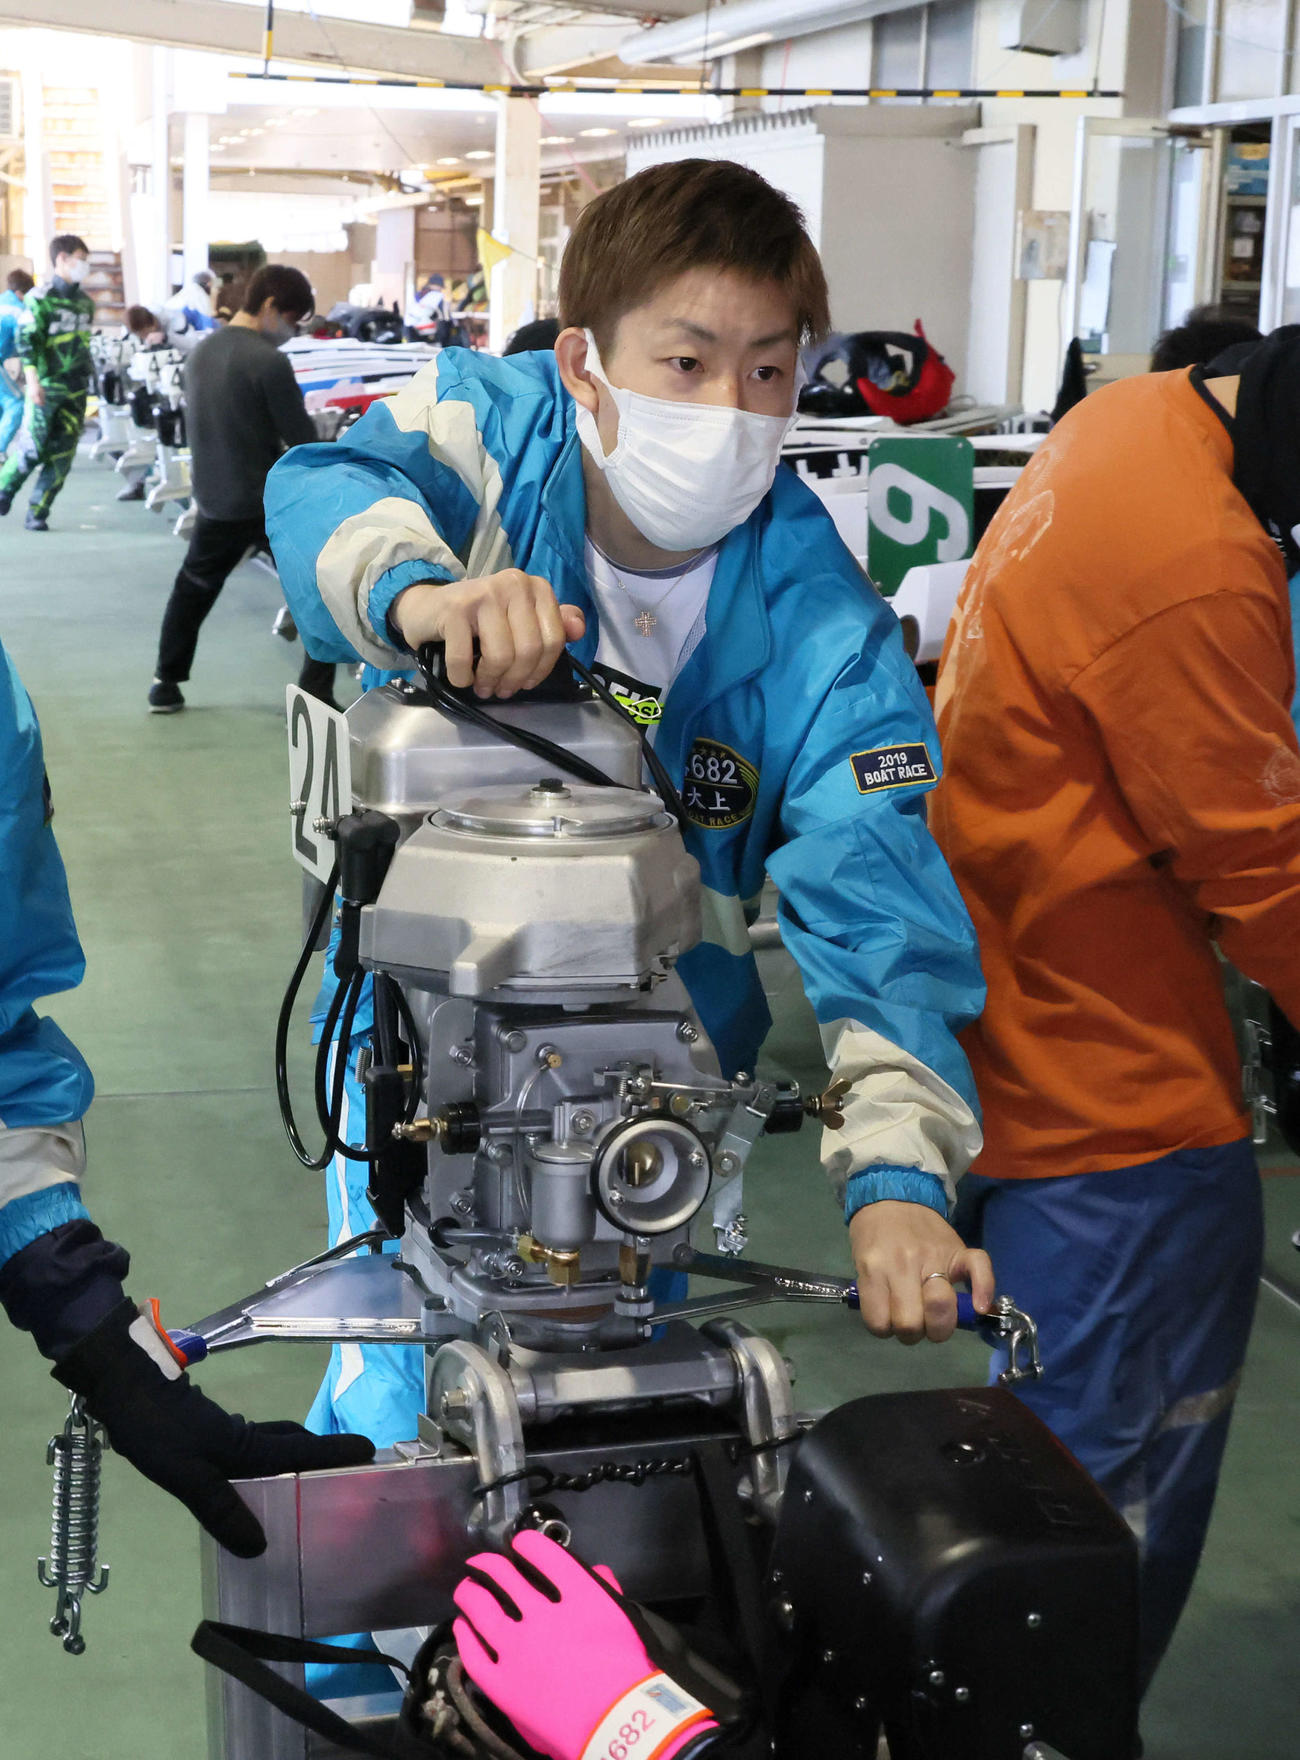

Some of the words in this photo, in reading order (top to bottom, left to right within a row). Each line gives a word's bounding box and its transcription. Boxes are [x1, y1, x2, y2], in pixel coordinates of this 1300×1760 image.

[877, 752, 908, 769] 2019
[864, 767, 897, 786] BOAT
[897, 763, 928, 780] RACE
[687, 786, 731, 811] 大上
[600, 1709, 657, 1760] 682
